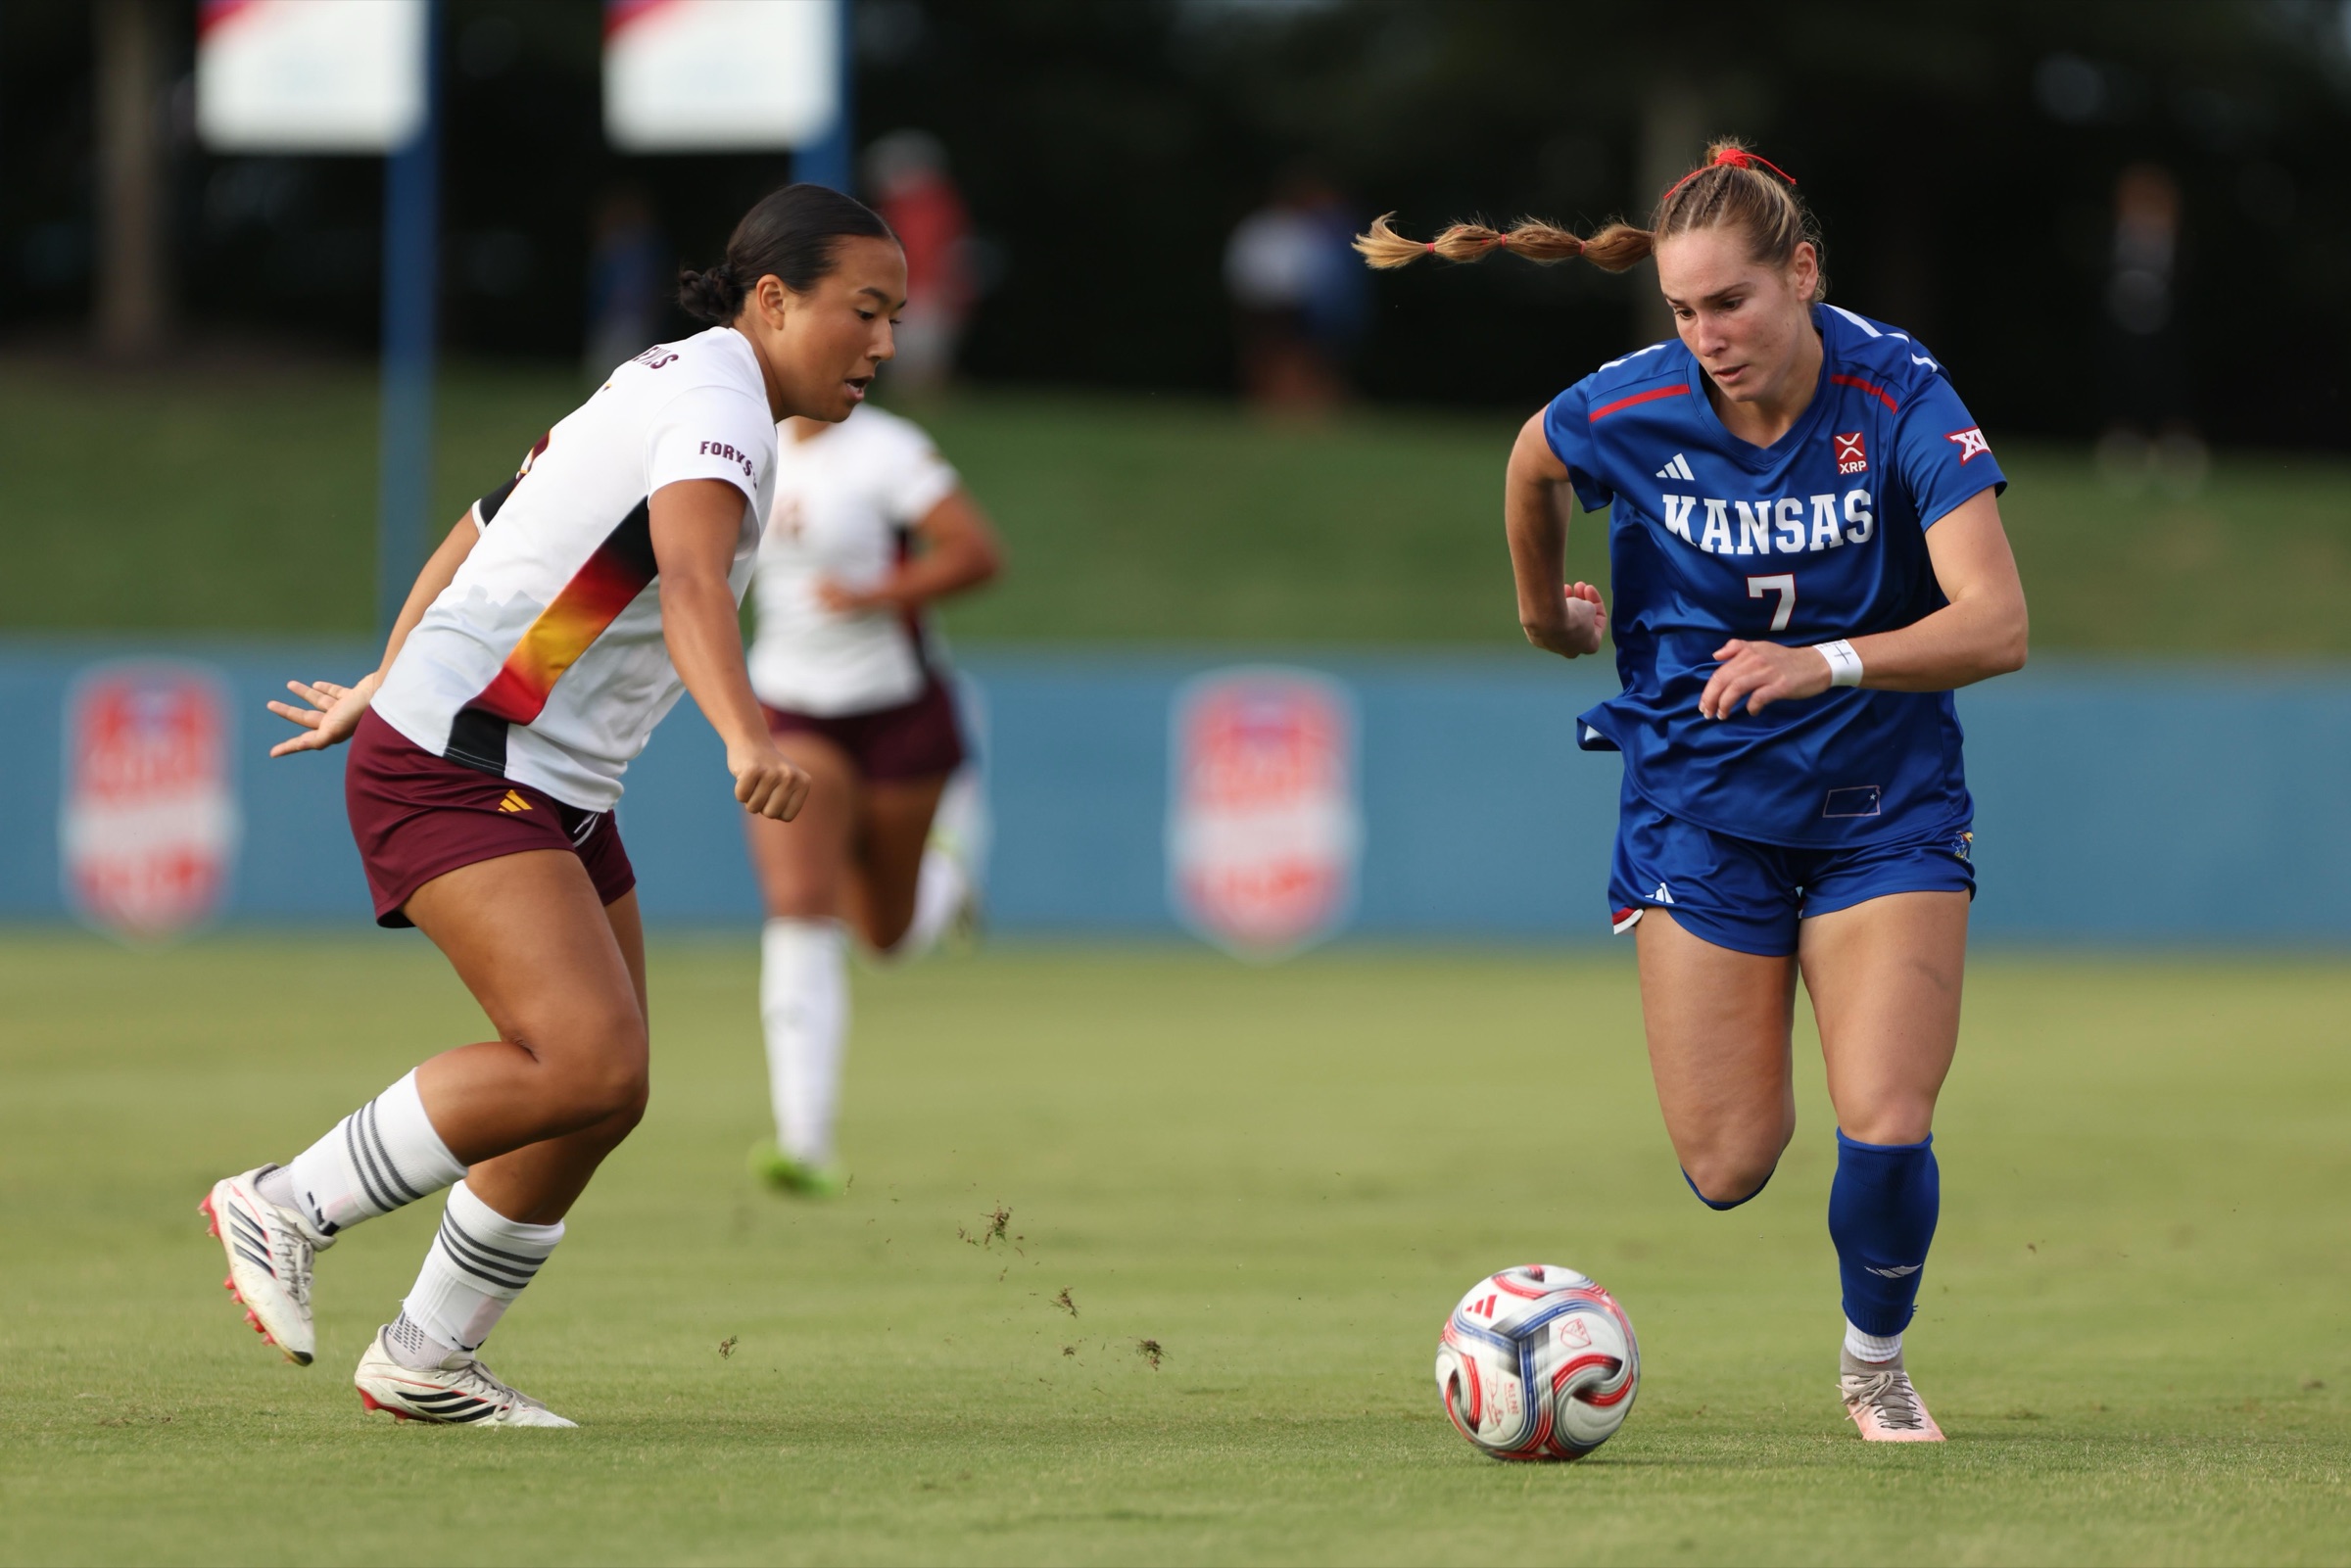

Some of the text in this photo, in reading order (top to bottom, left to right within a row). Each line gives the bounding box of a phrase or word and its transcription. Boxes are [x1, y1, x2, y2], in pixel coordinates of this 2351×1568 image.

[1839, 460, 1867, 475] XRP
[1662, 489, 1874, 555] KANSAS
[1746, 572, 1798, 632] 7
